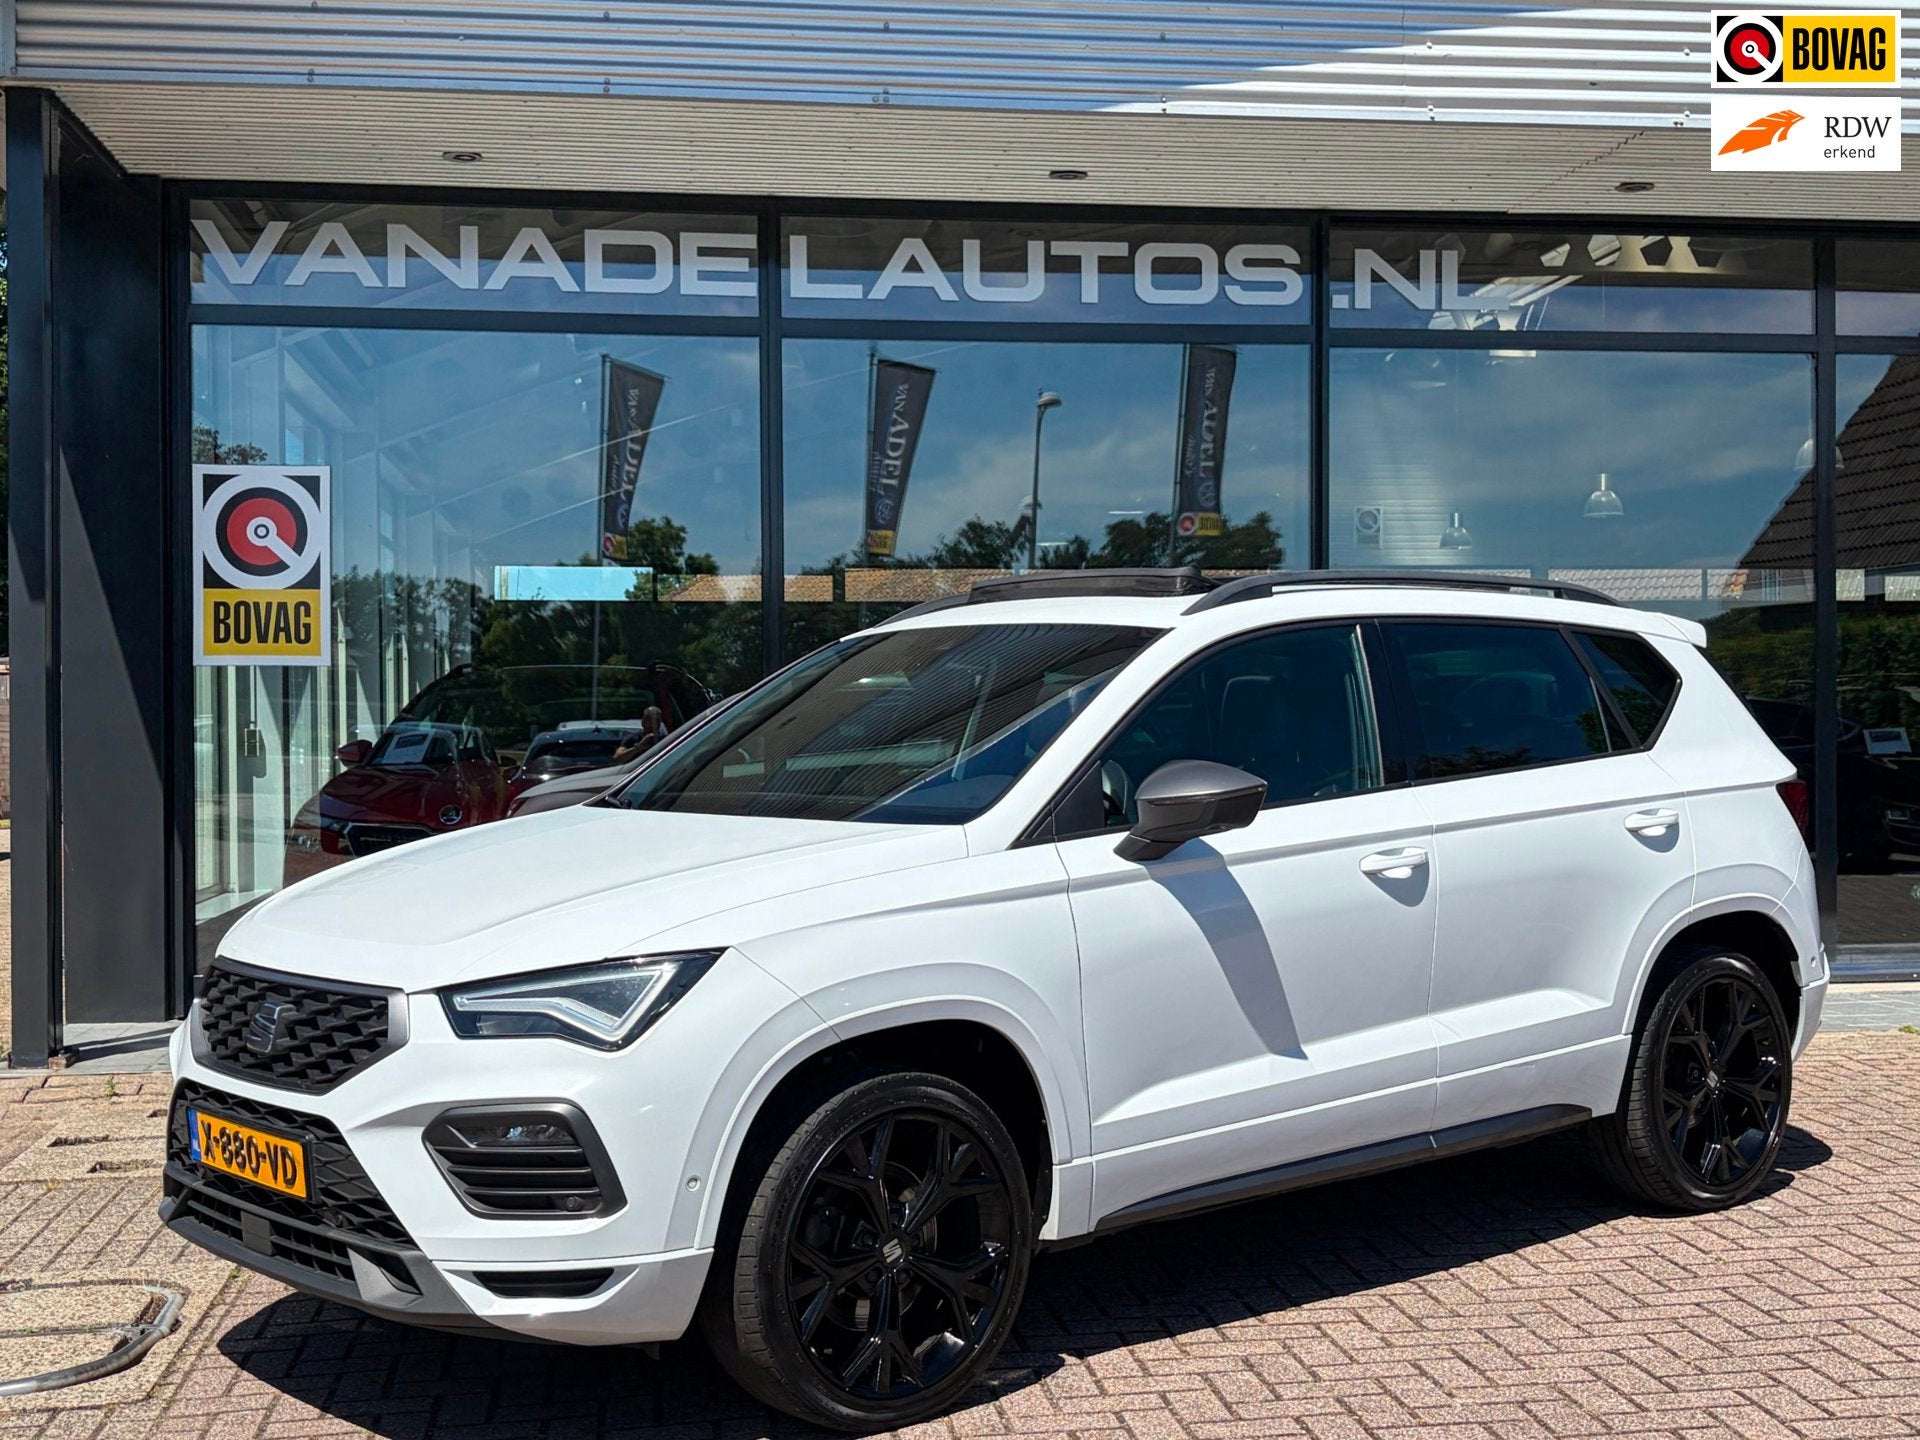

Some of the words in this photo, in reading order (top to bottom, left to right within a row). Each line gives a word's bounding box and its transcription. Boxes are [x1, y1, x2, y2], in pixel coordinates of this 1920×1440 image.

[877, 411, 909, 495] ADEL
[213, 600, 312, 645] BOVAG
[201, 1120, 298, 1189] X-880-VD
